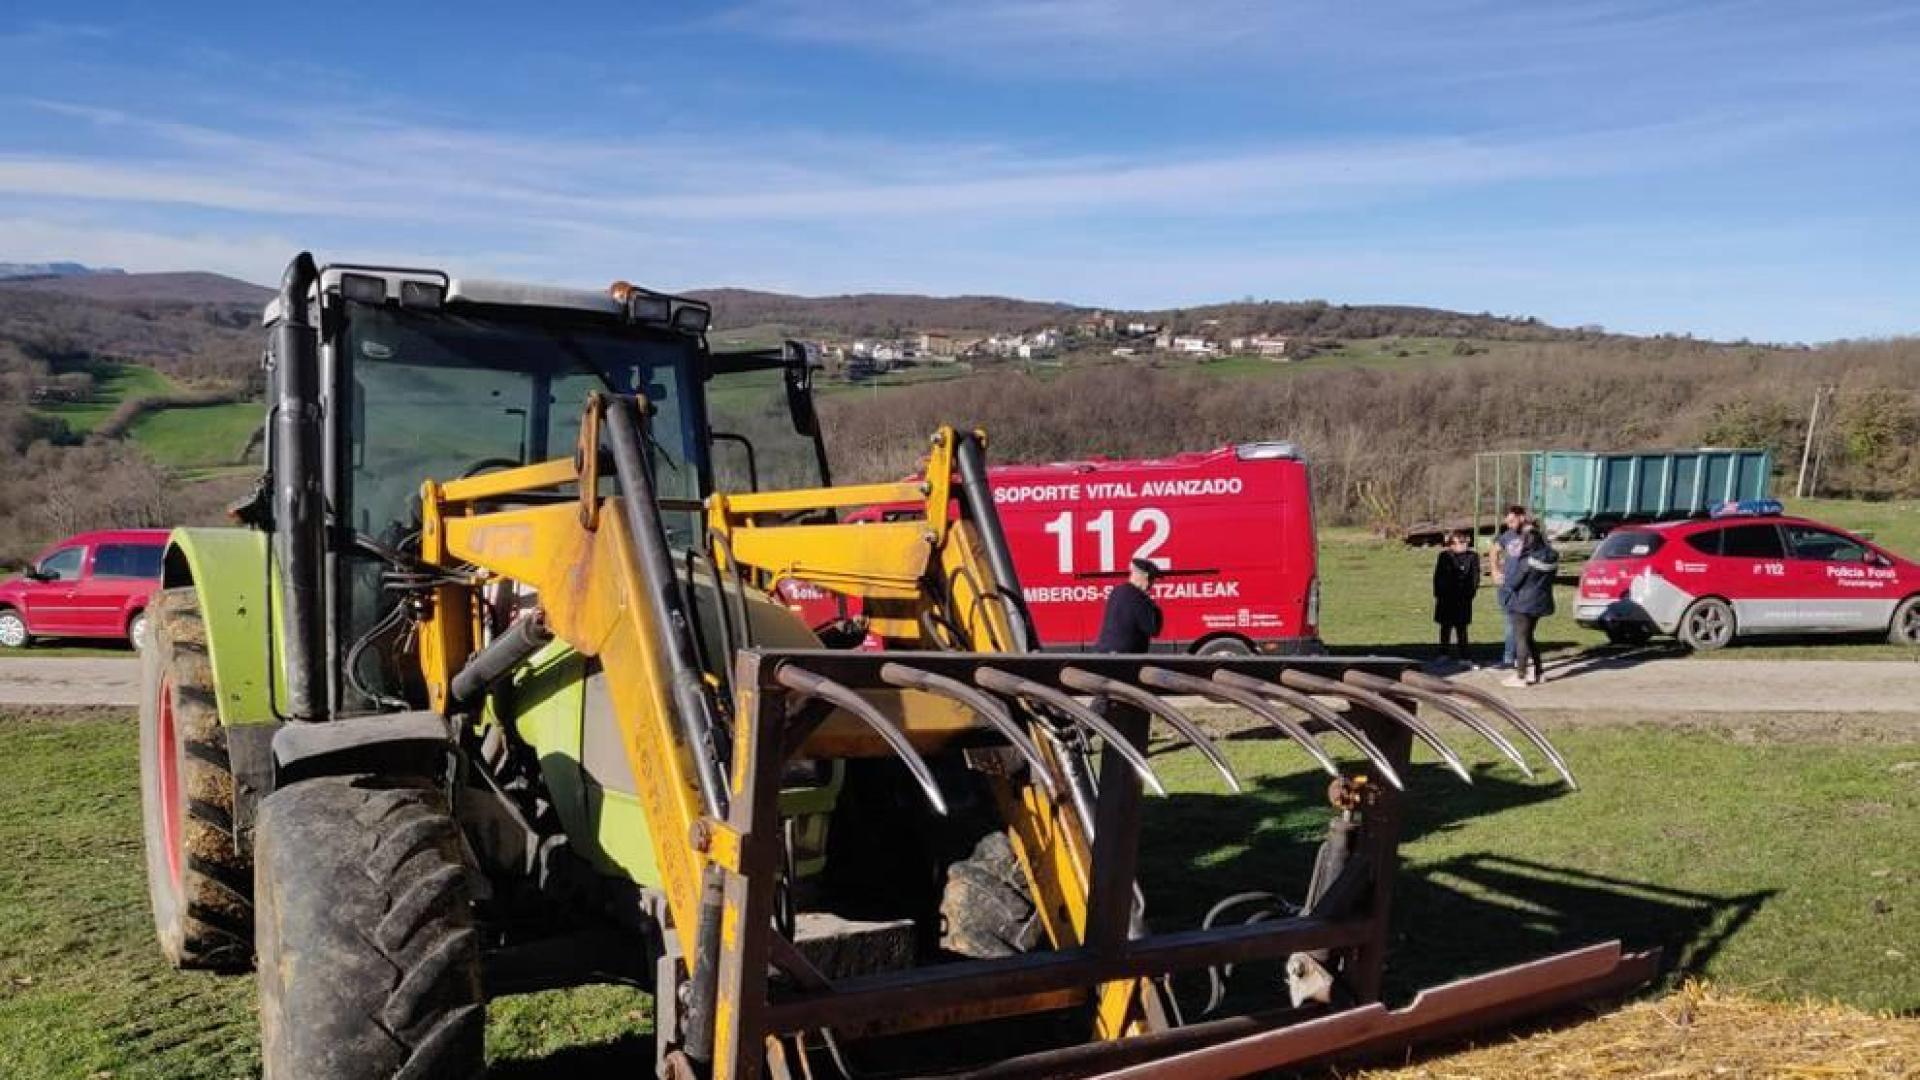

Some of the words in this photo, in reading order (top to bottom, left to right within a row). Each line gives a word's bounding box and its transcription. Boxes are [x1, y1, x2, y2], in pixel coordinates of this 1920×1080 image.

[994, 484, 1080, 503] SOPORTE
[1087, 482, 1138, 499] VITAL
[1141, 478, 1242, 497] AVANZADO
[1045, 508, 1171, 573] 112
